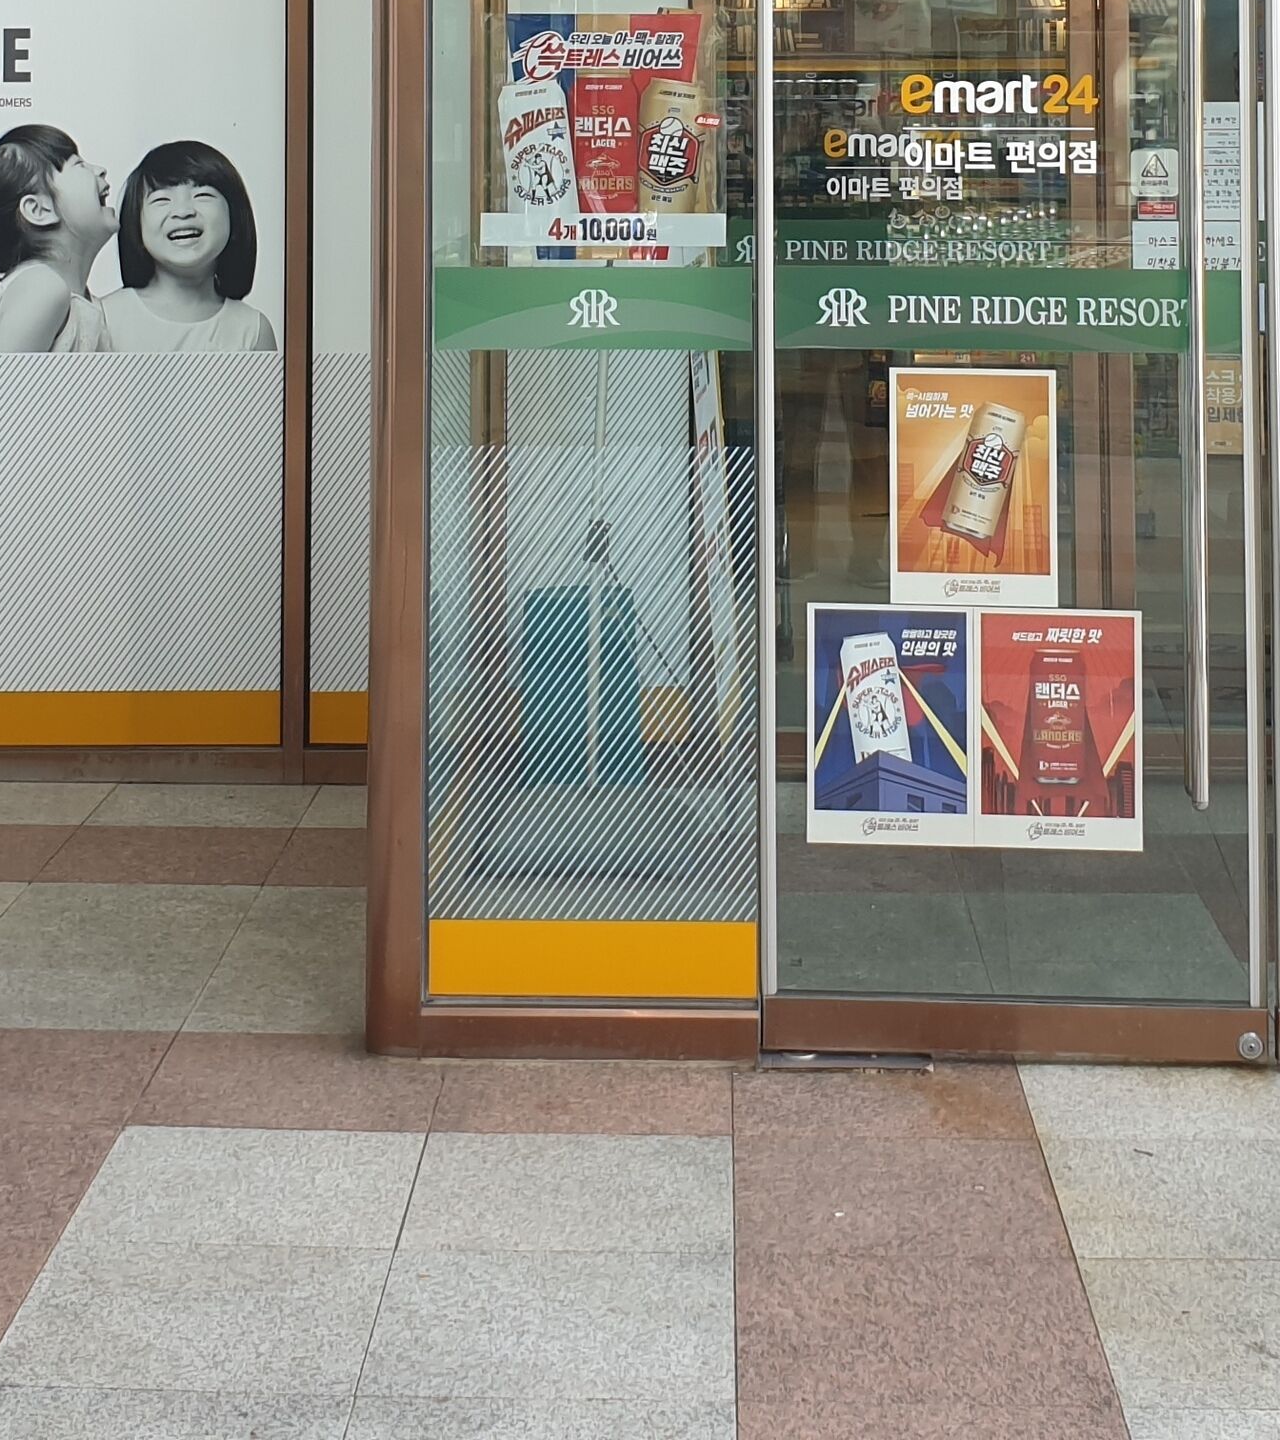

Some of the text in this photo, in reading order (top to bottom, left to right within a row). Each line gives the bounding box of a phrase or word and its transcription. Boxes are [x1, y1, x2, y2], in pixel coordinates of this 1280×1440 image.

[622, 48, 682, 68] 비어쓰
[900, 73, 1099, 115] emart24
[591, 105, 615, 114] SSG
[575, 117, 631, 137] 랜더스
[591, 138, 616, 148] LAGER
[648, 133, 689, 156] 최신
[511, 143, 537, 170] SUPER
[648, 153, 689, 176] 맥주
[904, 139, 1098, 174] 이마트 편의점
[826, 175, 963, 200] 이마트 편의점
[548, 217, 577, 241] 4개
[785, 239, 1051, 261] PINE RIDGE RESORT
[1148, 236, 1178, 247] 마스크
[888, 295, 1187, 327] PINE RIDGE RESOR
[1206, 369, 1235, 386] 스크
[905, 403, 974, 419] 넘어가는 맛
[973, 444, 1006, 466] 최신
[971, 459, 1003, 480] 맥주
[1045, 627, 1087, 644] 짜릿한
[1087, 628, 1103, 644] 맛
[901, 641, 958, 657] 인생의 맛
[1035, 682, 1080, 700] 랜더스
[1047, 700, 1068, 708] LAGER
[1033, 730, 1082, 741] LANDERS
